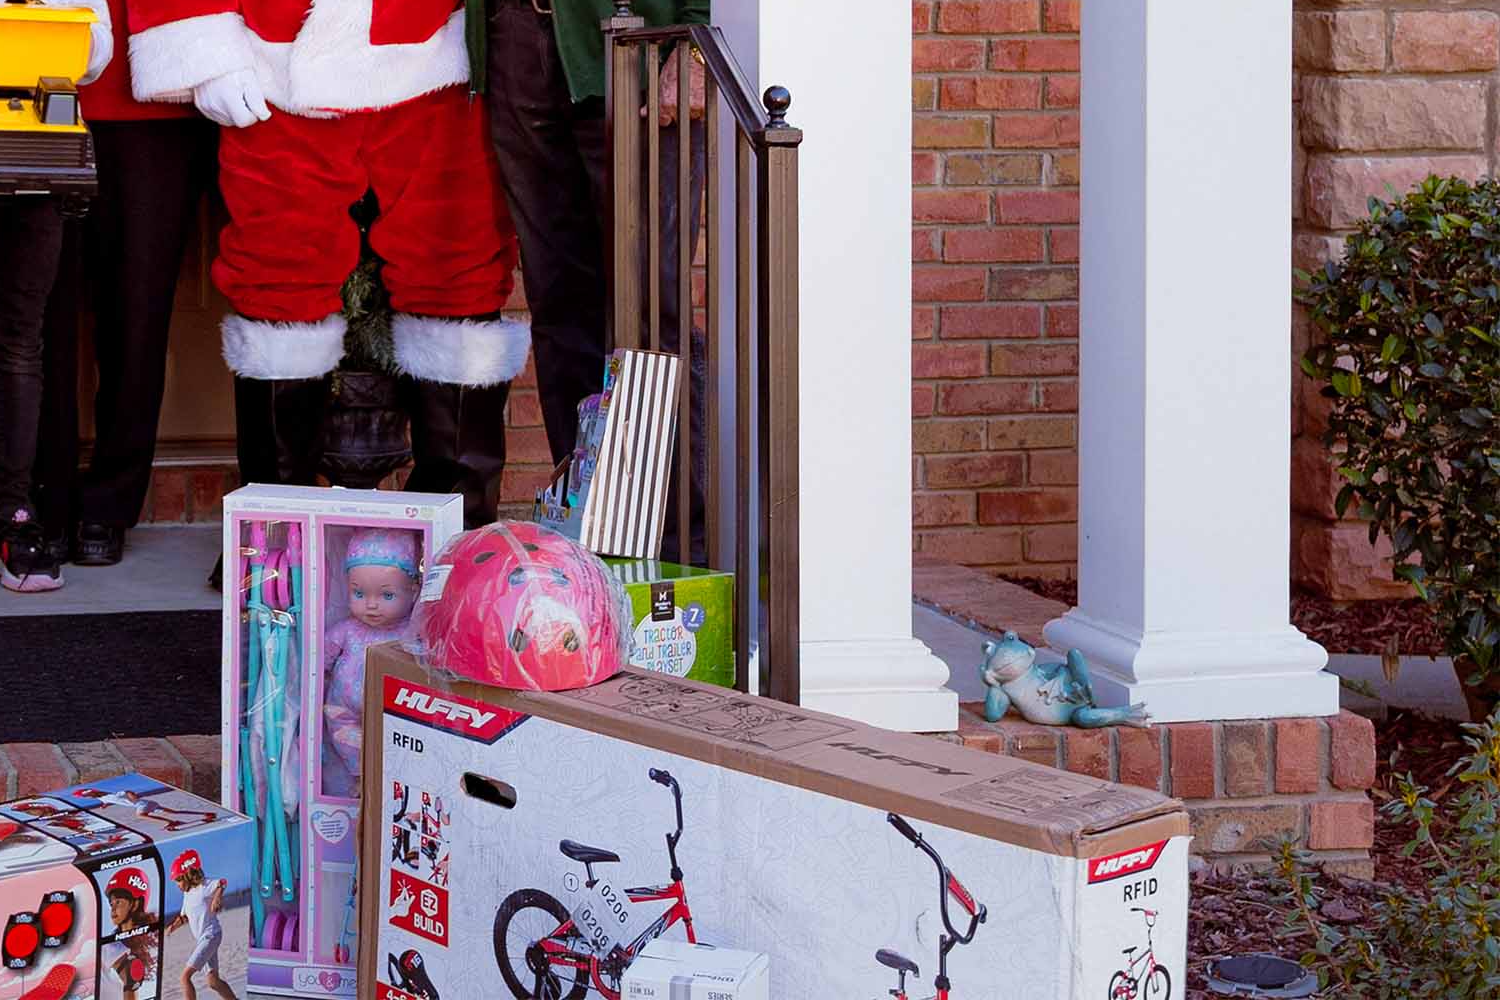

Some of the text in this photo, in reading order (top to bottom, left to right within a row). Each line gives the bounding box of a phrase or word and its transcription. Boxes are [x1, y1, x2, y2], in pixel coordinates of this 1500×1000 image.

[689, 607, 699, 622] 7
[394, 687, 498, 729] HUFFY
[392, 732, 425, 754] RFID
[101, 855, 143, 870] INCLUDES
[1094, 848, 1155, 876] HUFFY
[128, 874, 148, 890] HALO
[1123, 878, 1158, 902] RFID
[422, 894, 437, 912] EZ
[601, 884, 629, 924] 0206
[115, 926, 150, 941] HELMET
[413, 912, 445, 938] BUILD
[581, 908, 610, 948] 0206
